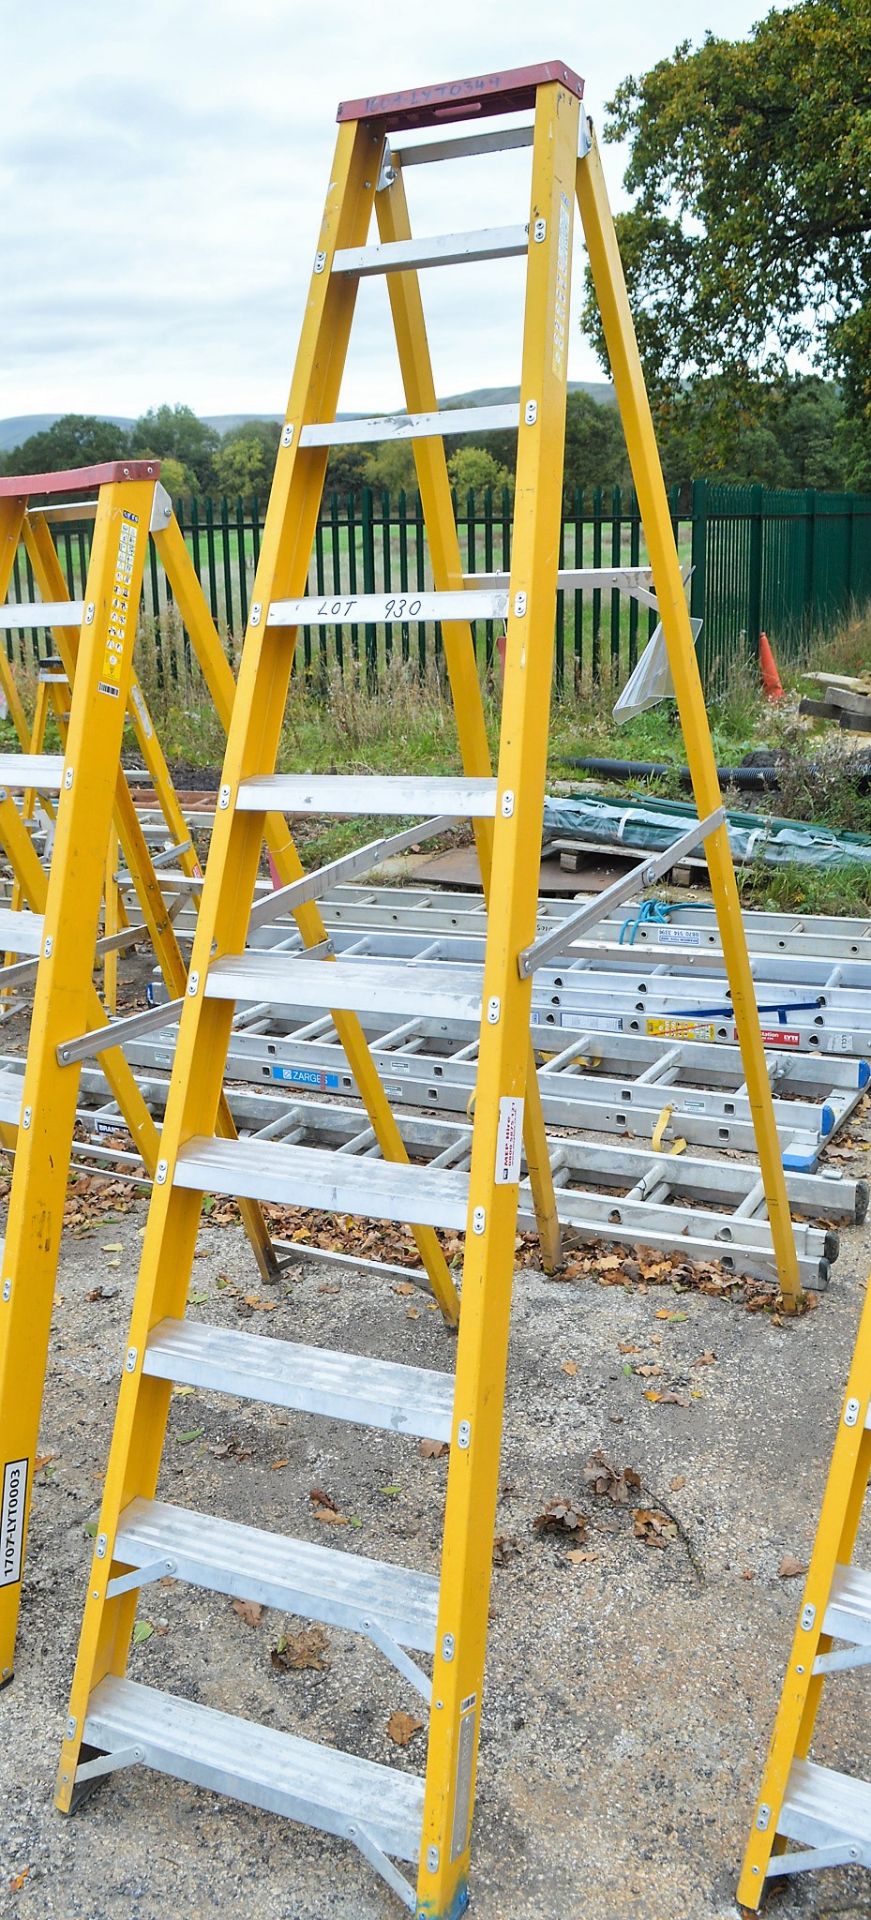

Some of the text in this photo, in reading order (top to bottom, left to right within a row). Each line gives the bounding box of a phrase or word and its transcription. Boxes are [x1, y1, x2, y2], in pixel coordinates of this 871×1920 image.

[317, 599, 421, 619] LOT 930
[4, 1468, 20, 1577] 1707-LYT0003
